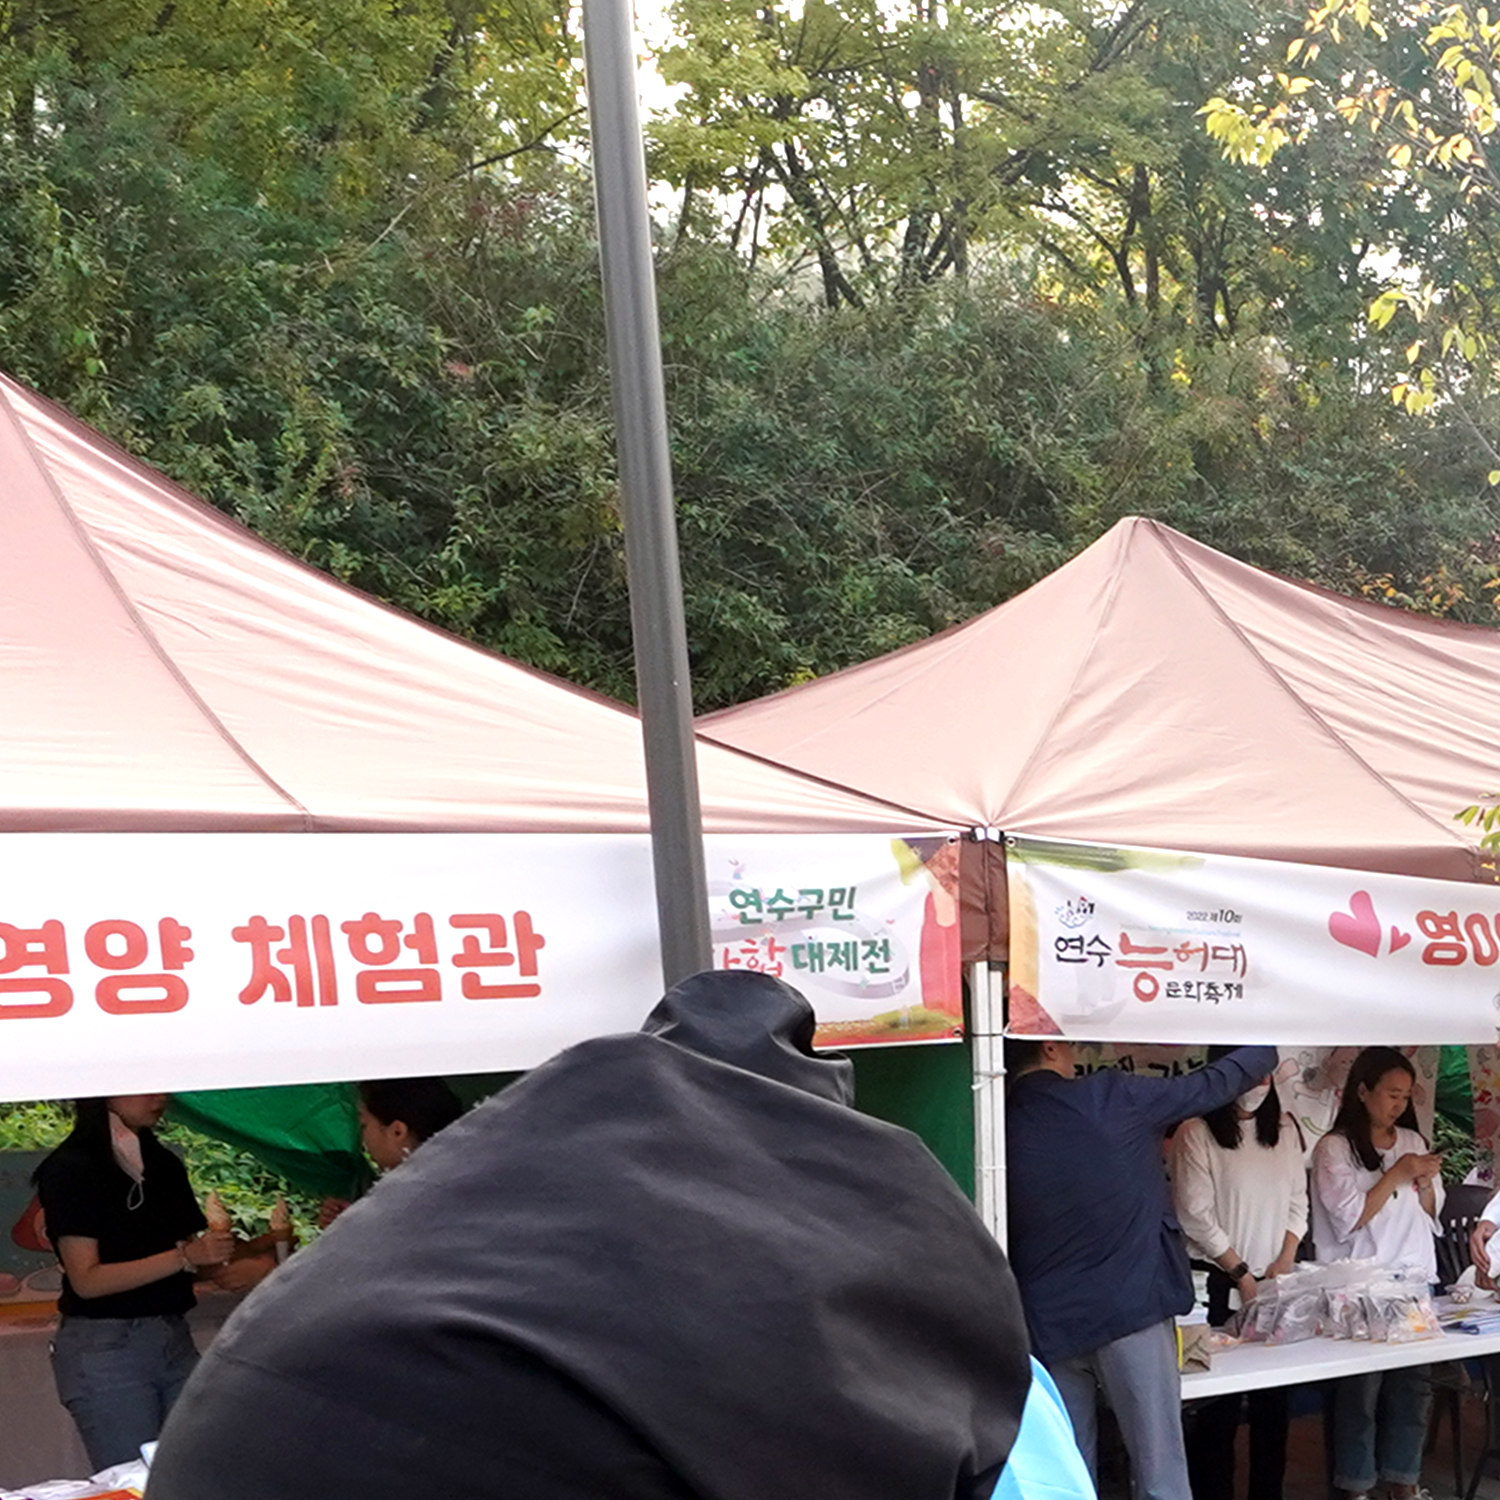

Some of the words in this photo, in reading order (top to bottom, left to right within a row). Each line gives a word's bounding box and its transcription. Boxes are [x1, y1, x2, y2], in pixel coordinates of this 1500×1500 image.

[728, 886, 858, 925] 연수구민
[0, 917, 194, 1020] 영양
[231, 909, 546, 1008] 체험관
[790, 938, 892, 974] 대제전
[1054, 934, 1113, 968] 연수
